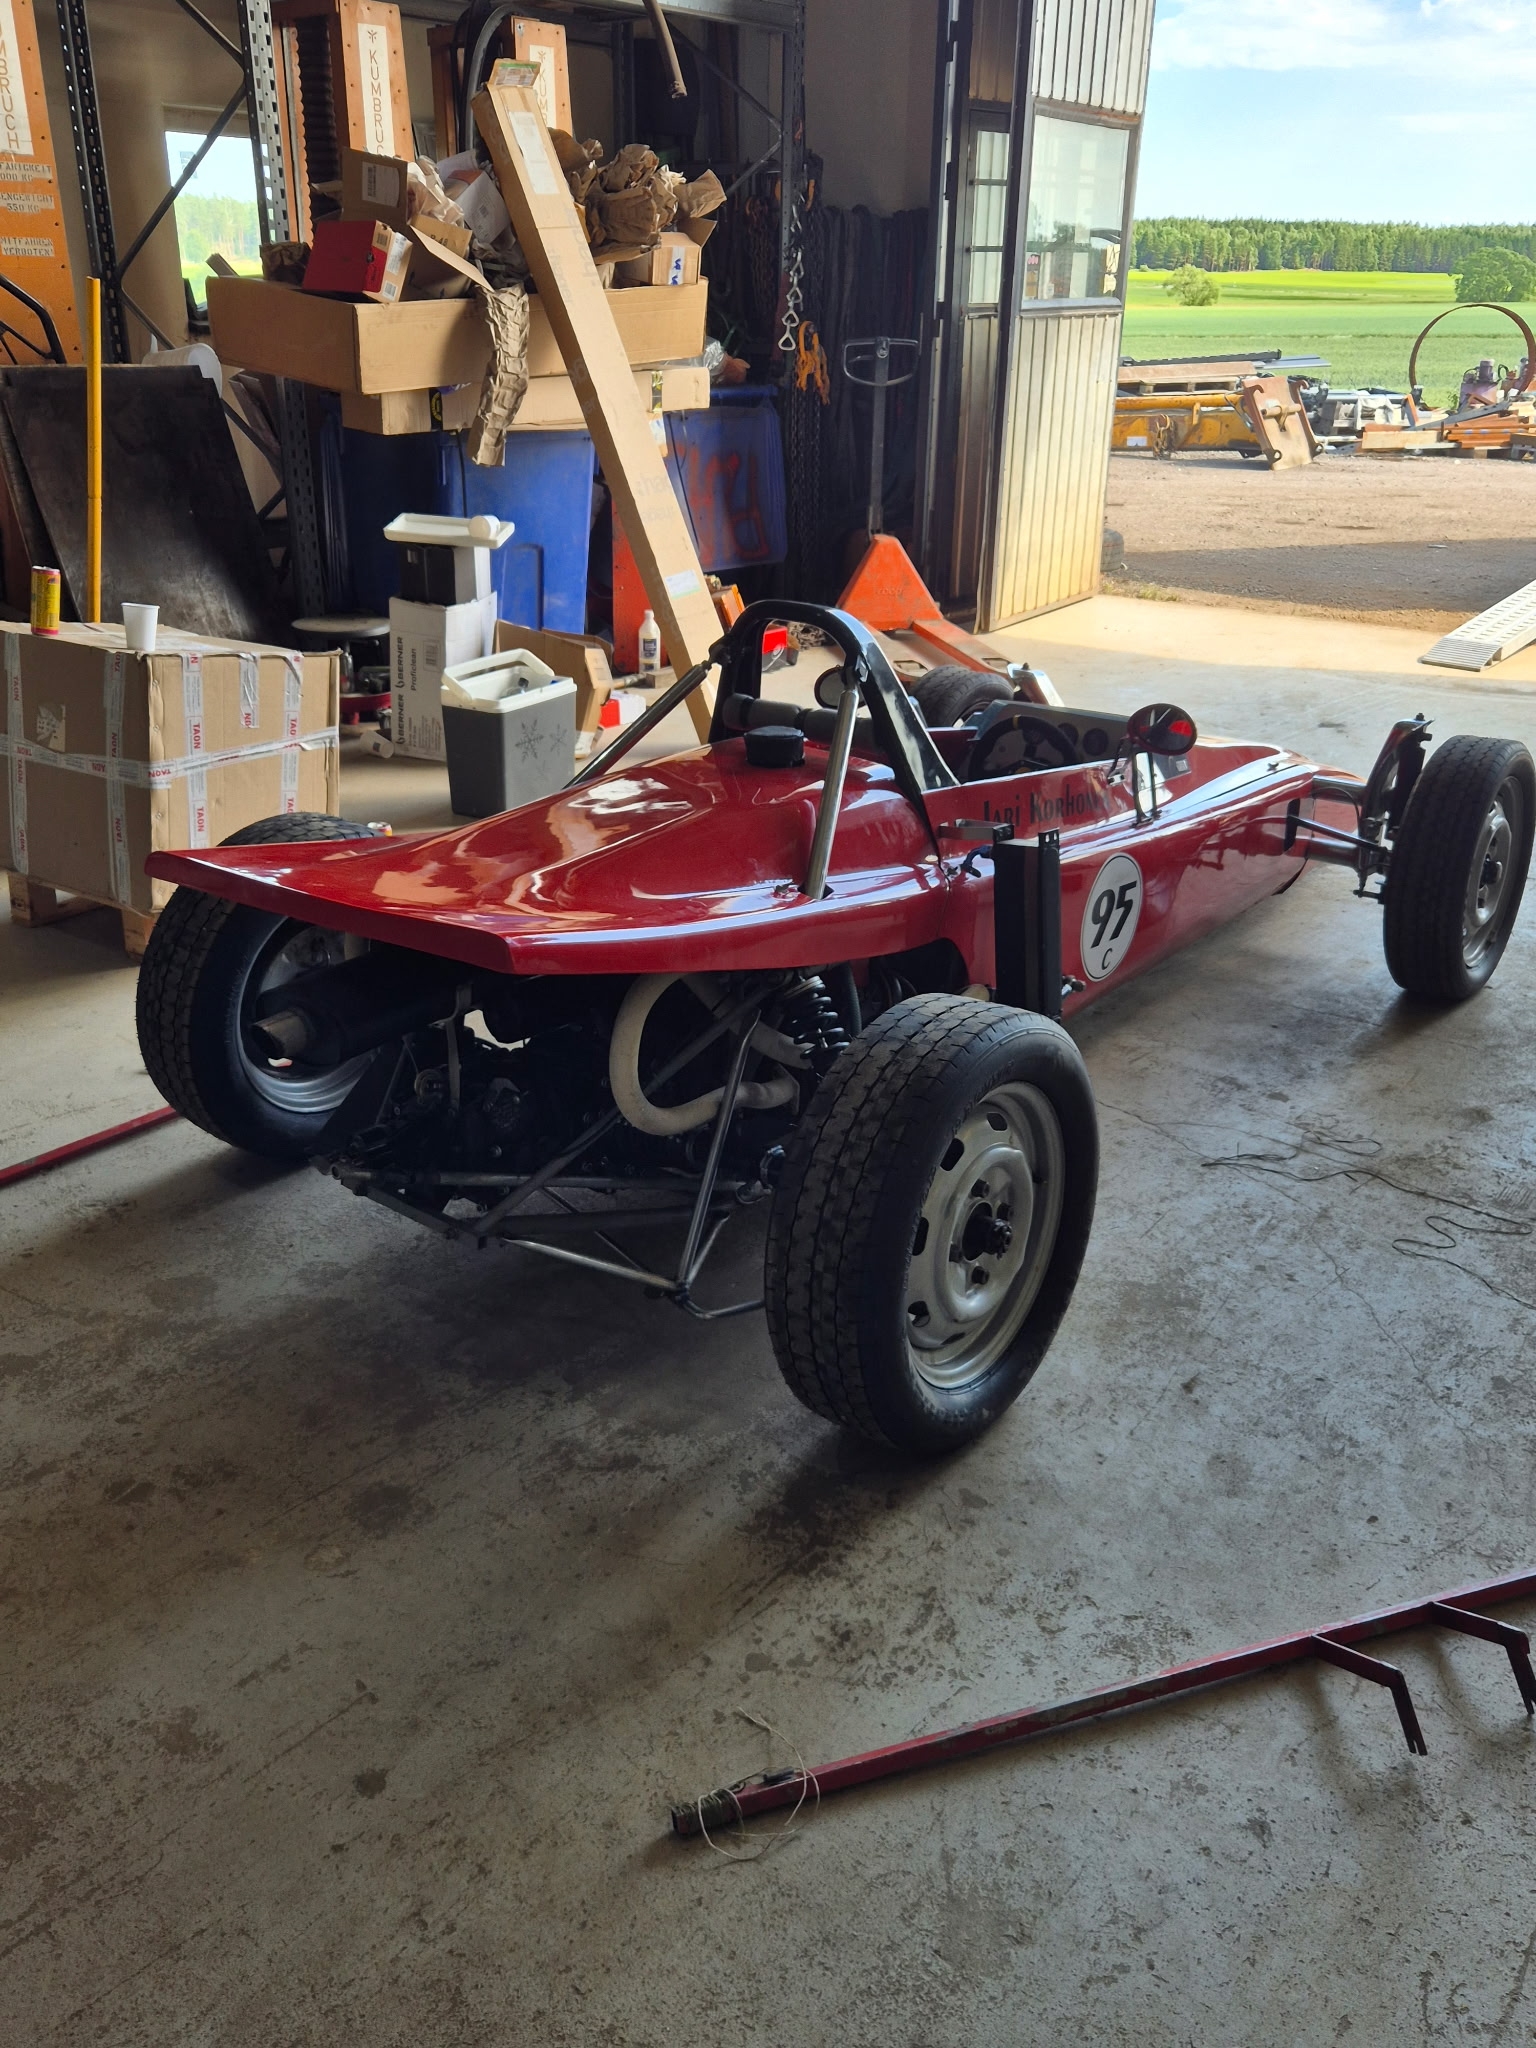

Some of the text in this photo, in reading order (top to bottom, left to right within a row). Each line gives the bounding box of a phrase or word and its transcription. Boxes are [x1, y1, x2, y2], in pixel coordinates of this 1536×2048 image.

[369, 49, 384, 155] KUMBRUC
[192, 723, 202, 749] TAON
[290, 717, 298, 736] TAO
[148, 768, 171, 778] TAON
[115, 818, 123, 843] TAON
[196, 807, 205, 833] TAON
[1090, 880, 1137, 949] 95
[1102, 948, 1113, 971] C
